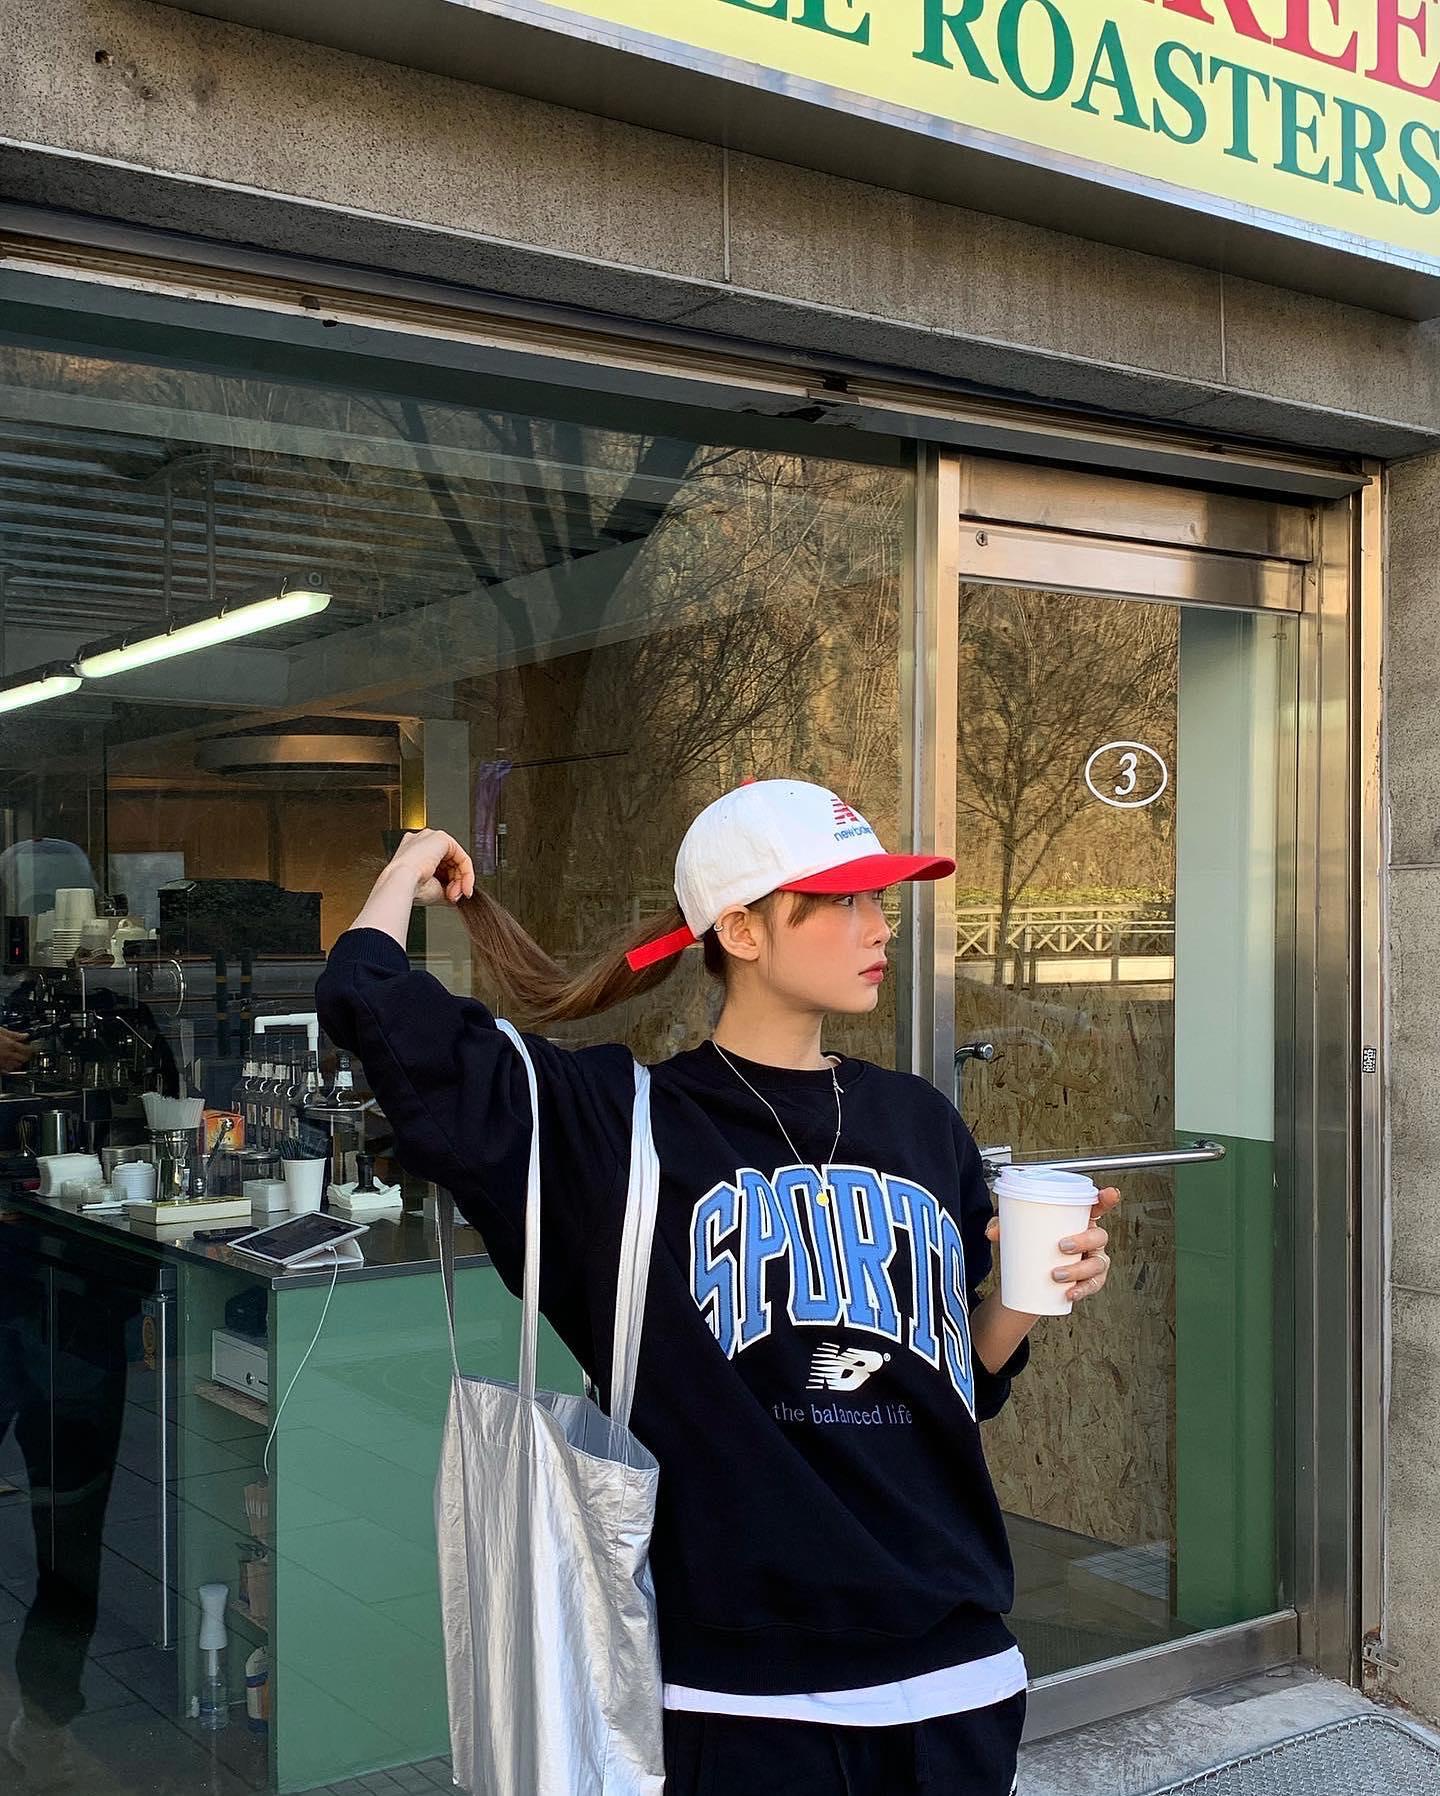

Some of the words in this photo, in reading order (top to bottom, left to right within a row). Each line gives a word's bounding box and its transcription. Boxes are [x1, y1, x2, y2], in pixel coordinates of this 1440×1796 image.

[911, 0, 1440, 215] ROASTERS
[1115, 752, 1138, 796] 3
[690, 1163, 977, 1423] SPORTS
[773, 1401, 805, 1422] the
[811, 1403, 883, 1425] balanced
[886, 1403, 913, 1425] life
